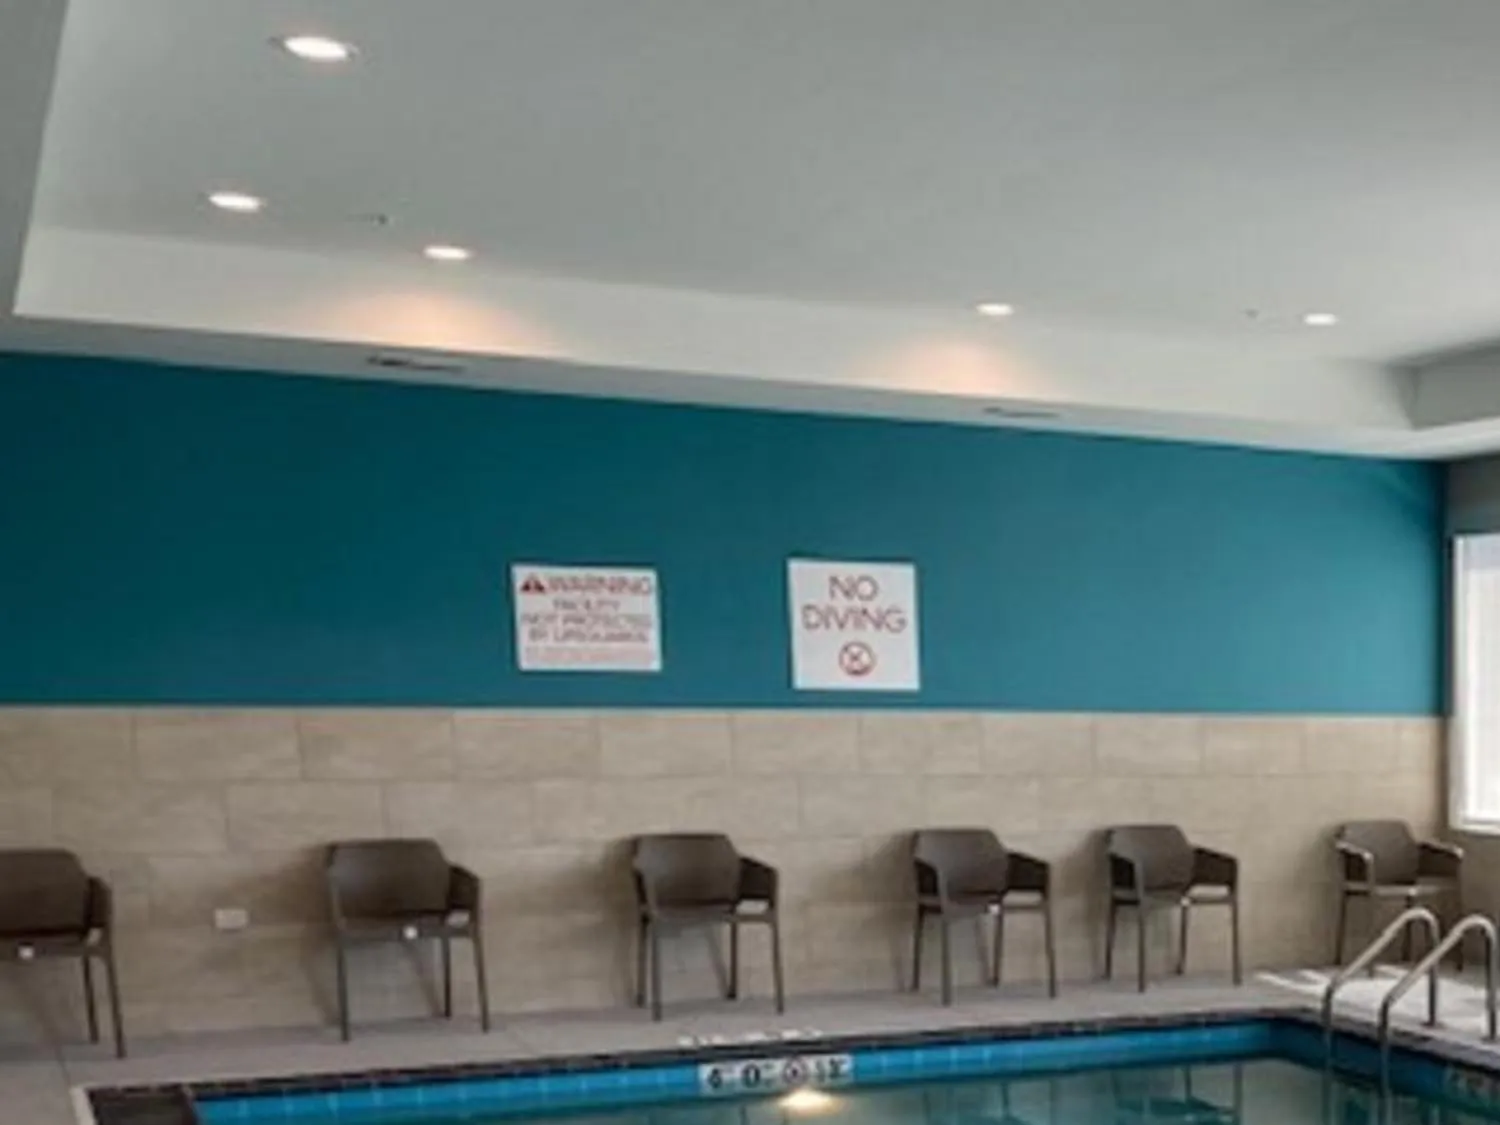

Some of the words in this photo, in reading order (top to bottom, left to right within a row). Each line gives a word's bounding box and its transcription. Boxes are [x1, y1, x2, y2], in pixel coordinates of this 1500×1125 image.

[548, 575, 652, 595] WARNING
[829, 575, 878, 601] NO
[802, 604, 907, 633] DIVING
